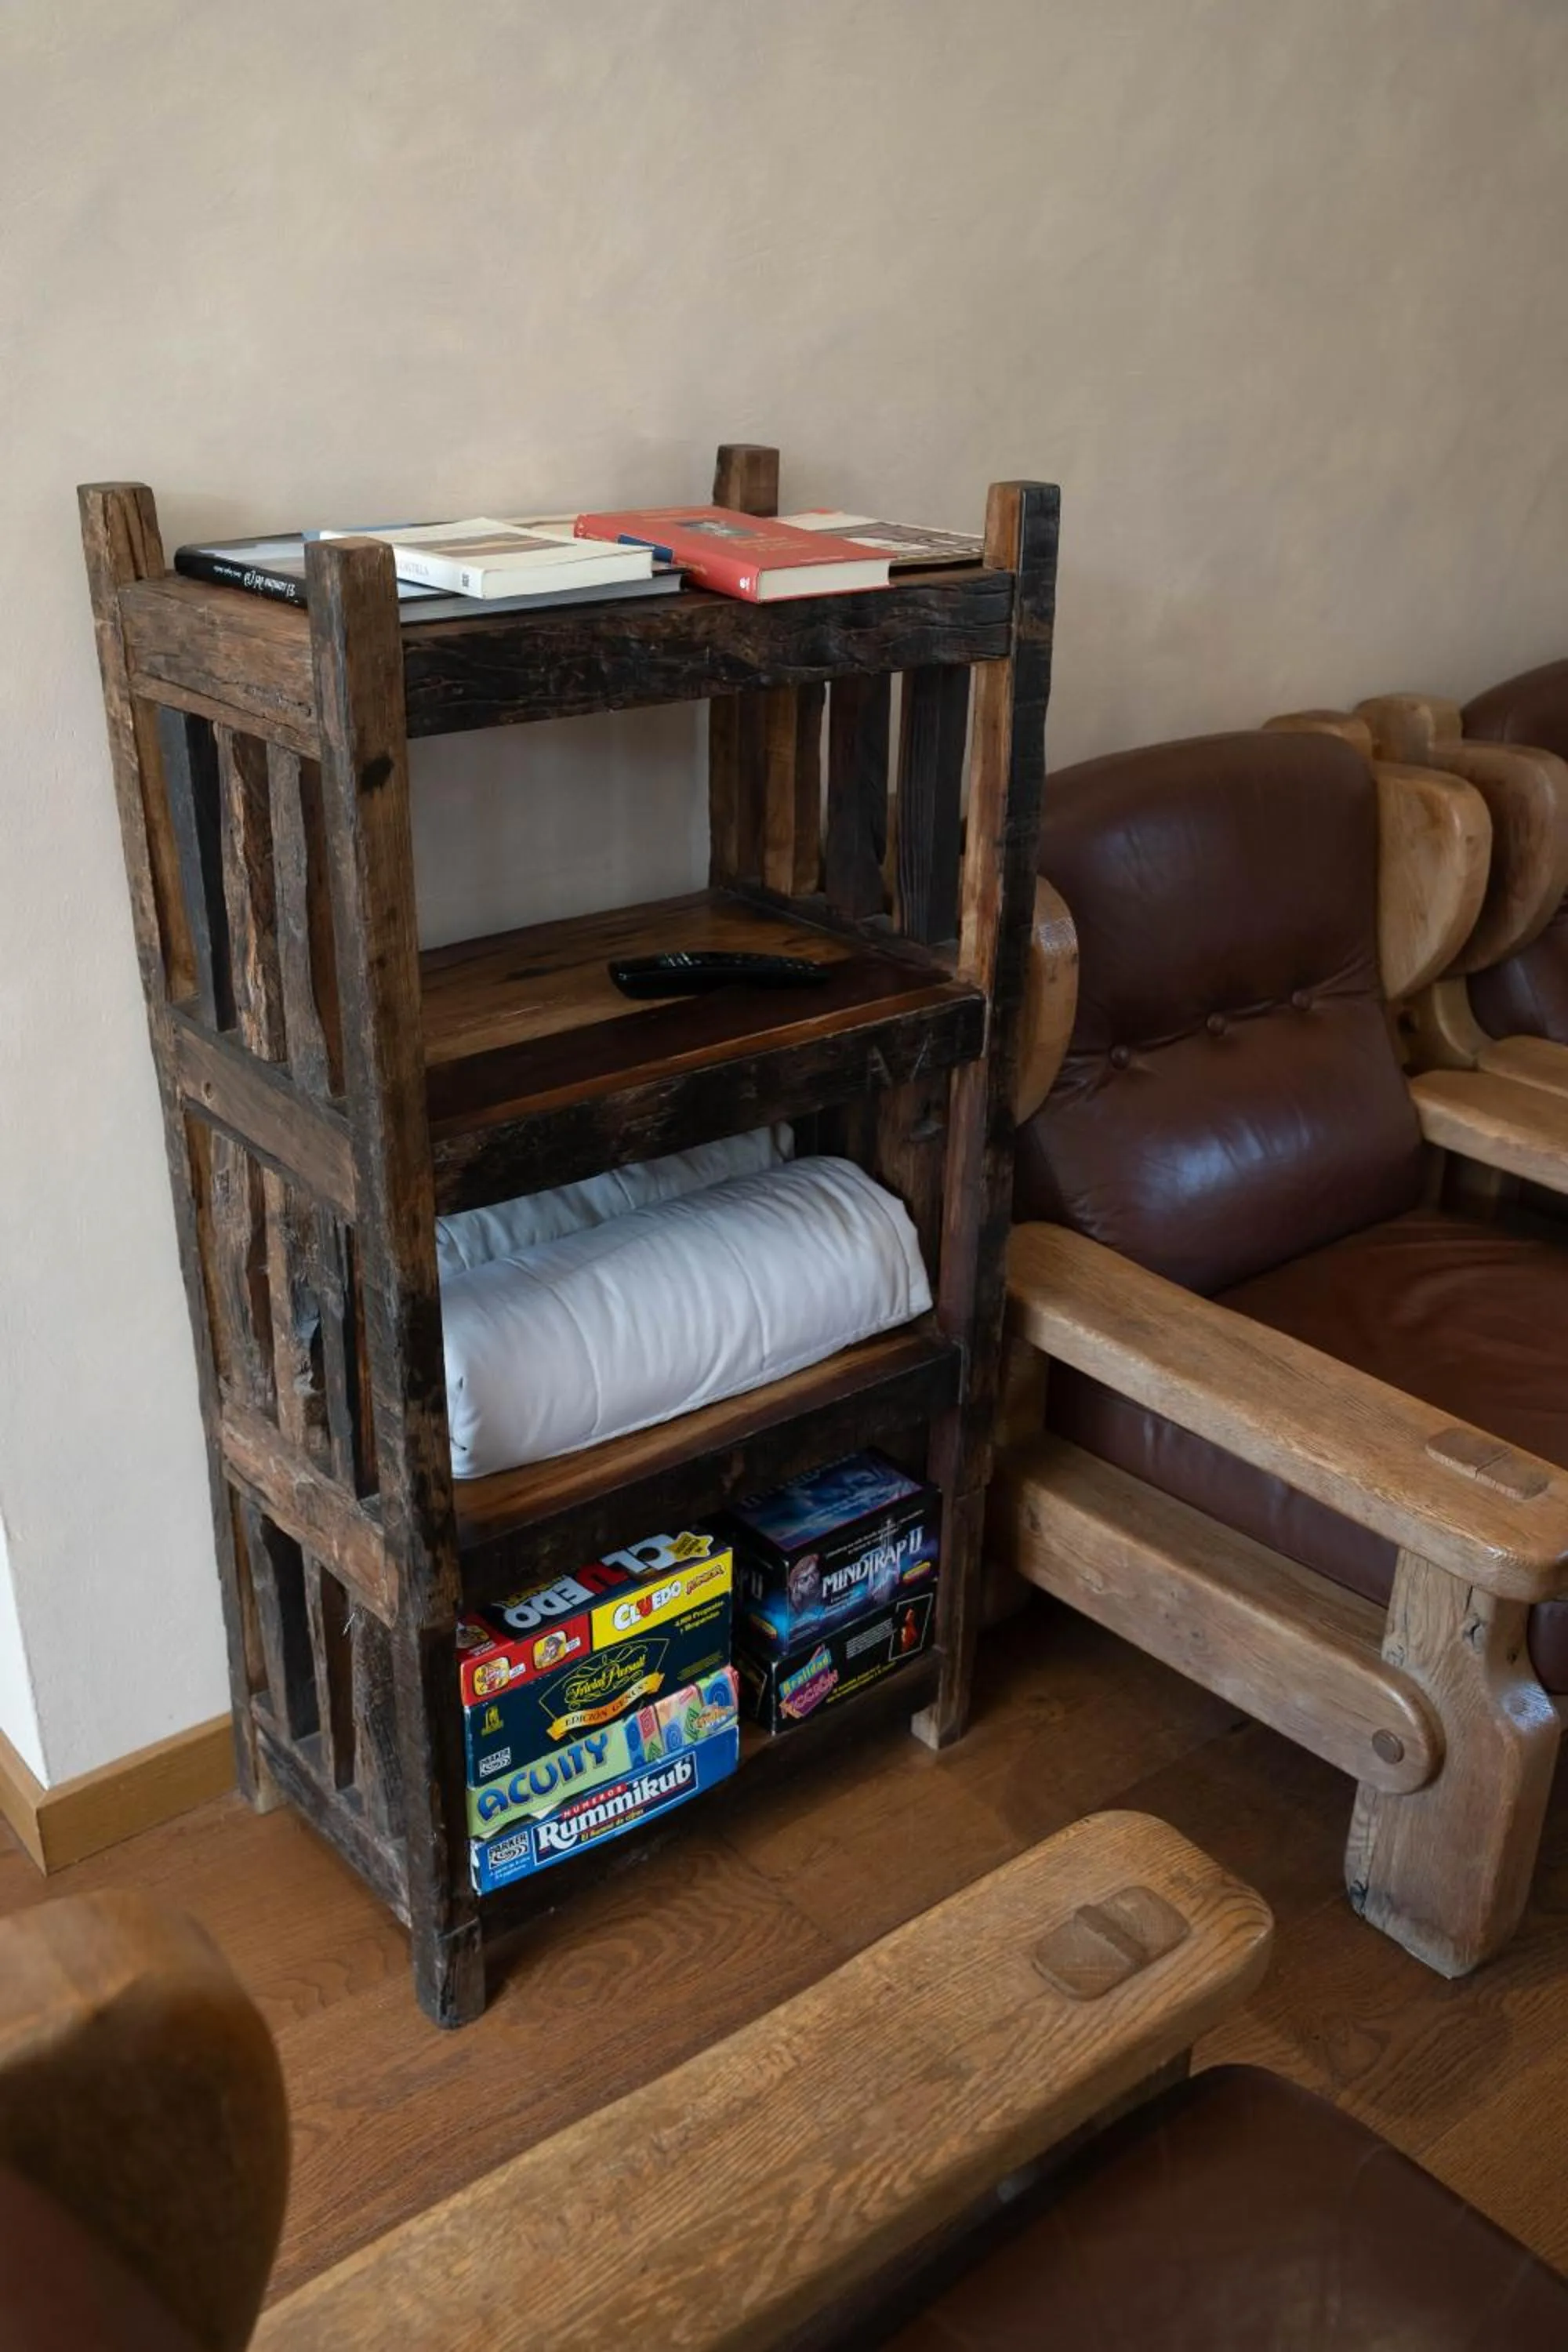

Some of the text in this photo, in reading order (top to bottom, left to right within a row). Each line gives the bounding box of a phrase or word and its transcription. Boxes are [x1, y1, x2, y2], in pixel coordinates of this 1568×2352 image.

[504, 1534, 679, 1629] CLUEDO
[612, 1580, 682, 1632] CLUEDO
[567, 1673, 608, 1701] Trivial
[604, 1654, 646, 1691] Pursuit
[477, 1732, 608, 1821] ACUITY
[536, 1760, 691, 1850] Rummikub
[489, 1831, 528, 1855] PARKER
